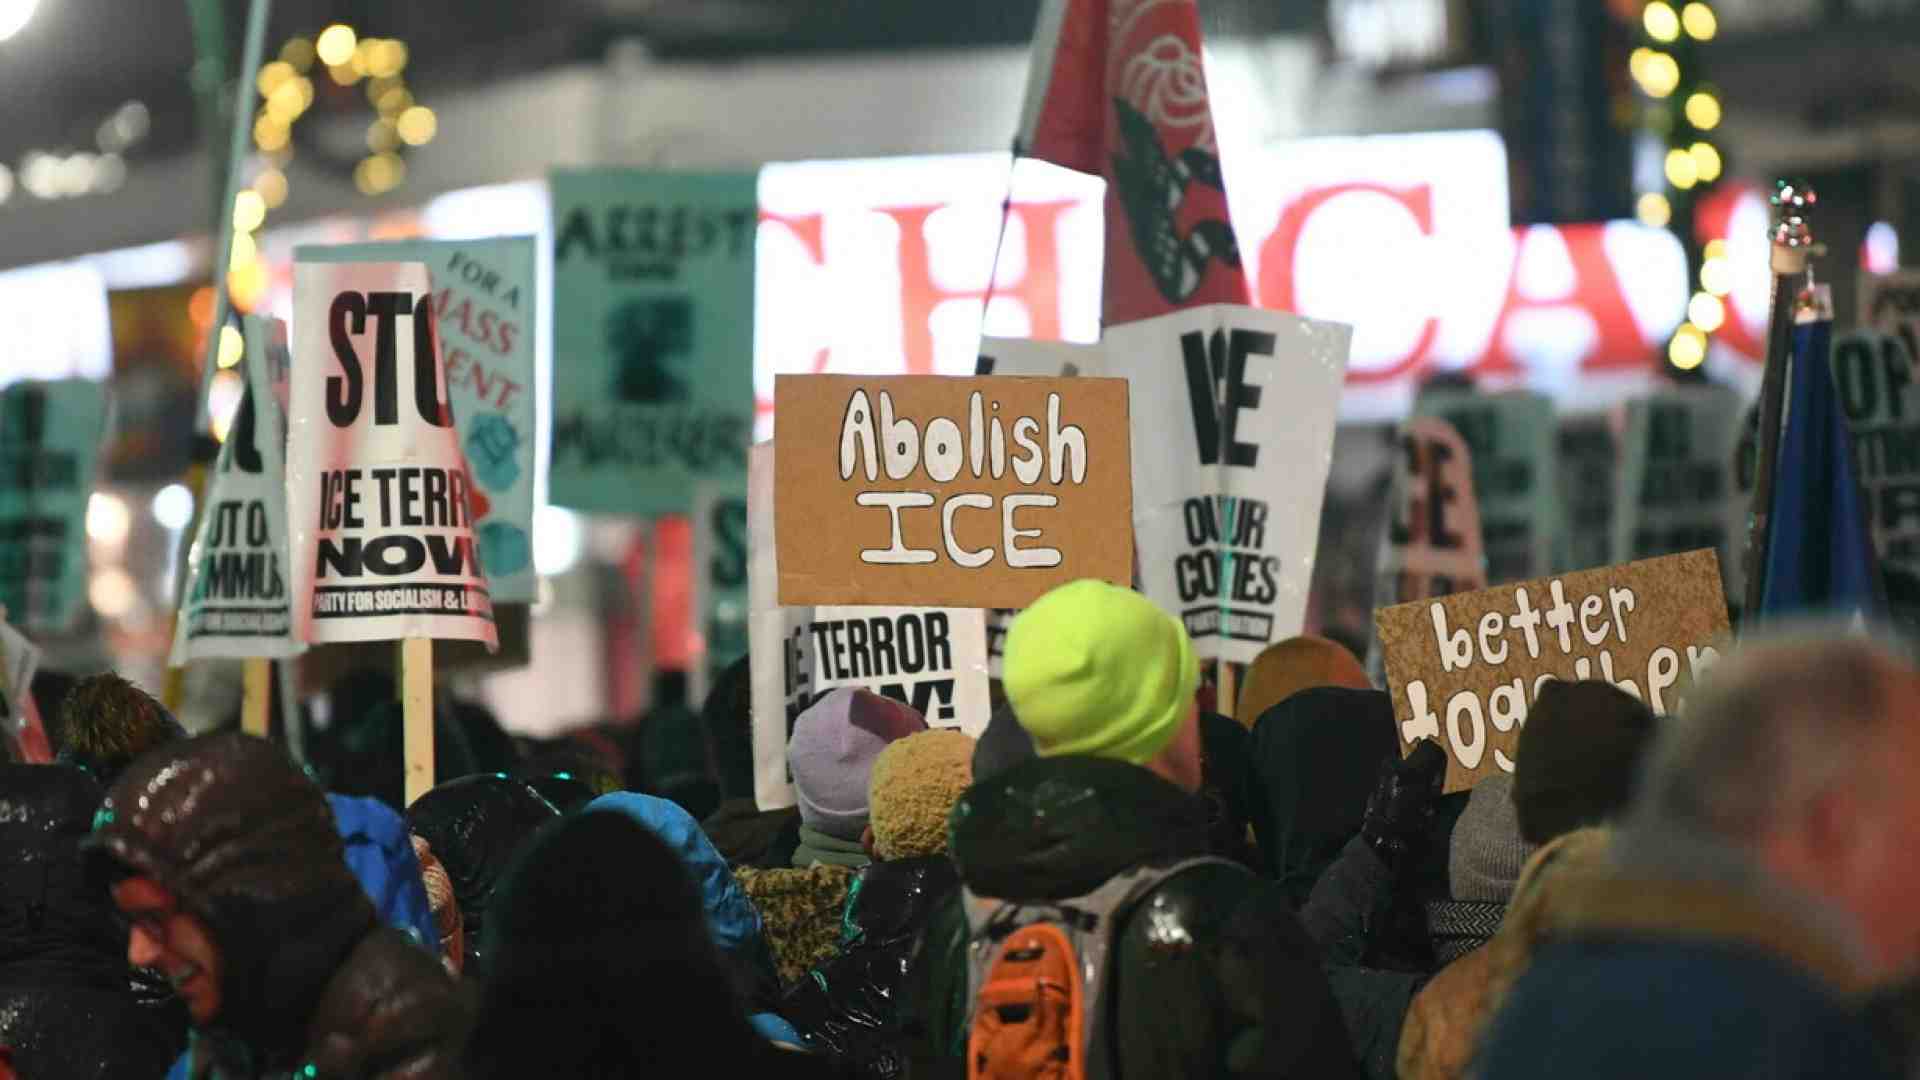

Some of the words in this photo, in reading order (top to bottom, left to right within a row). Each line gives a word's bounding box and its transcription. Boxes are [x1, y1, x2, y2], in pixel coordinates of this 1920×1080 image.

[446, 250, 503, 296] FOR
[441, 339, 522, 409] ENT
[838, 388, 1089, 486] Abolish
[319, 468, 365, 532] ICE
[855, 491, 1063, 569] ICE
[347, 591, 374, 611] FOR
[375, 588, 442, 610] SOCIALISM
[444, 590, 459, 608] &
[1429, 578, 1636, 673] better
[809, 611, 952, 681] TERROR
